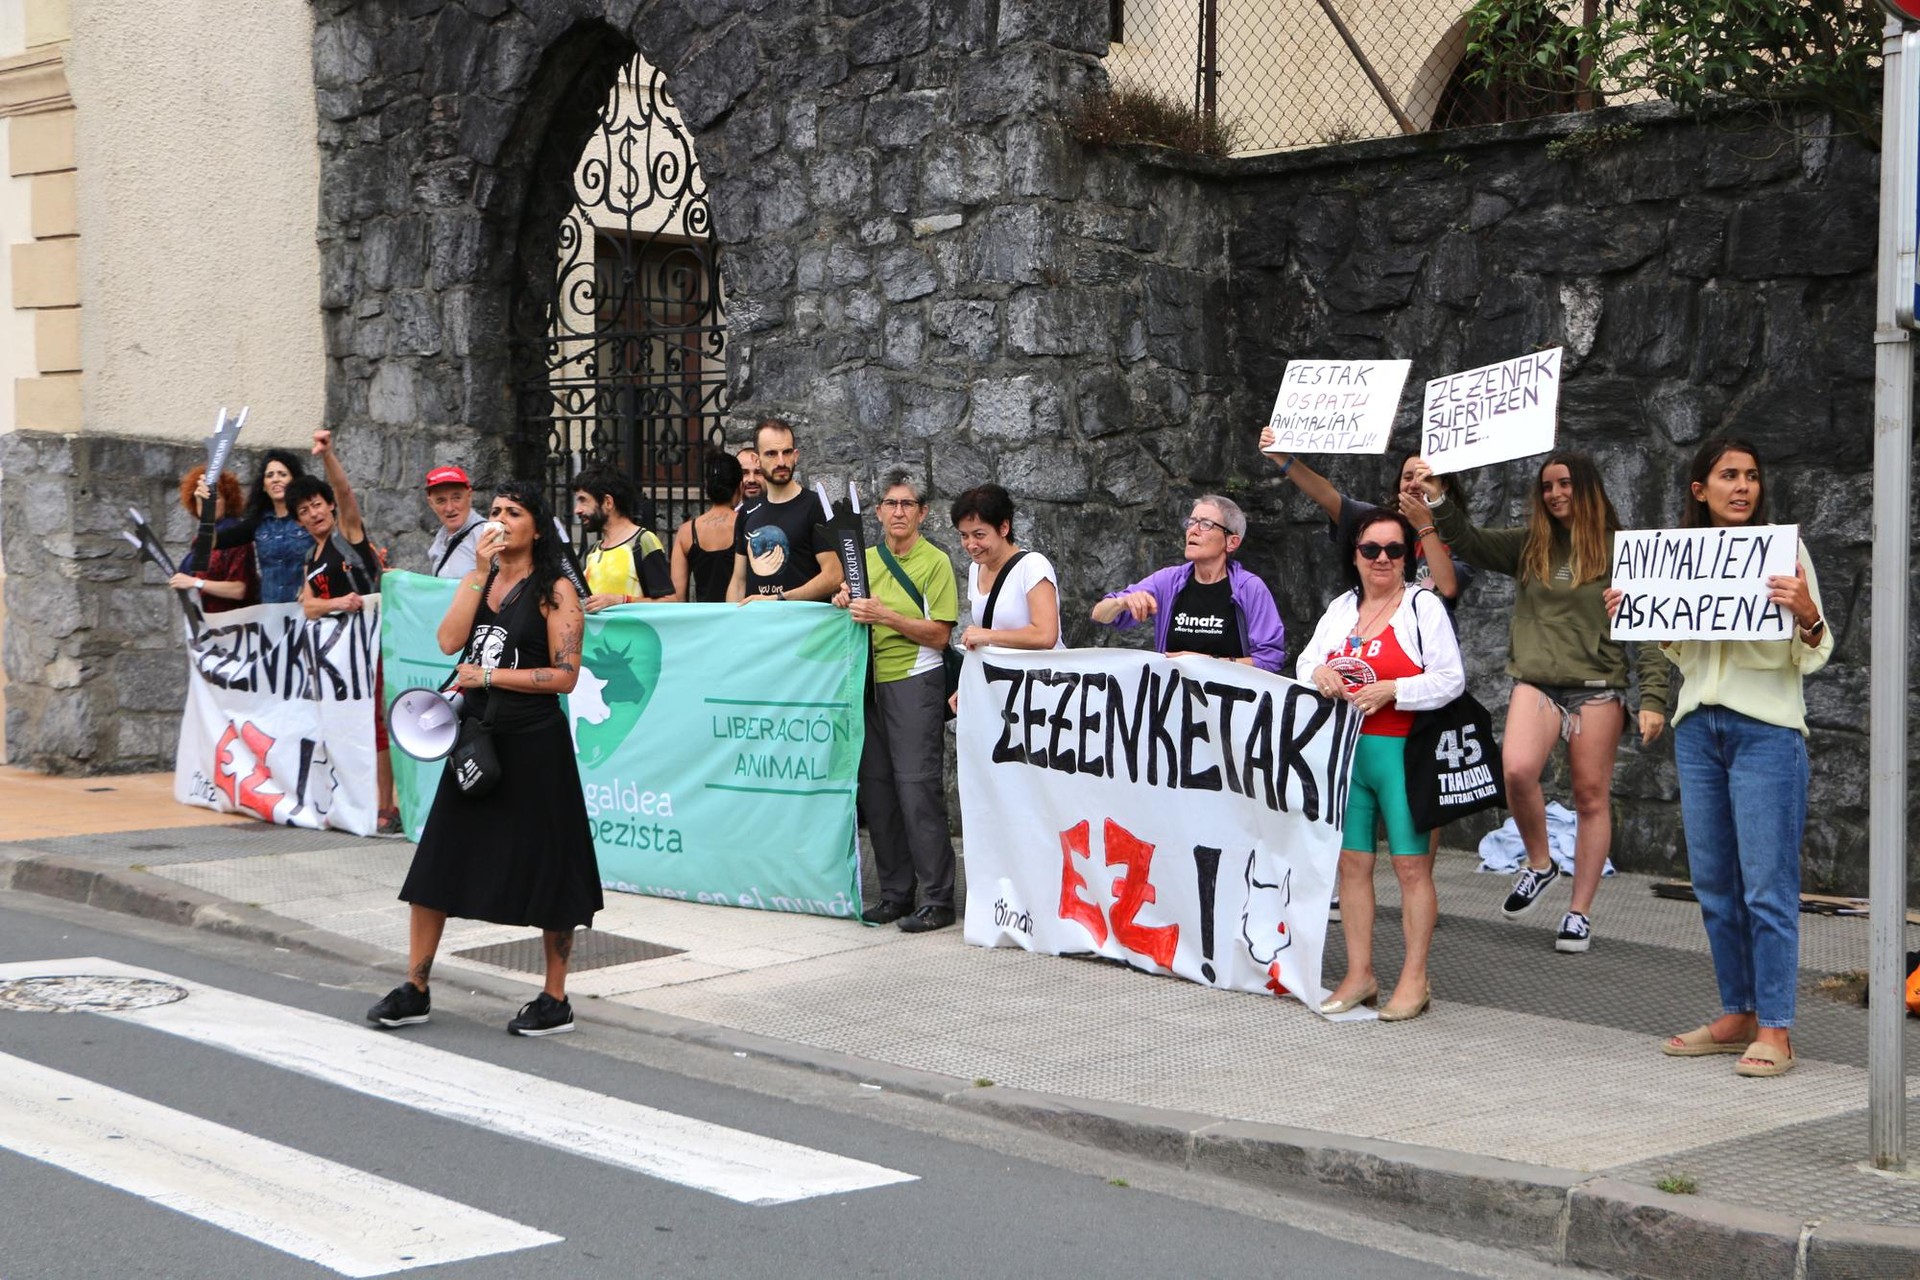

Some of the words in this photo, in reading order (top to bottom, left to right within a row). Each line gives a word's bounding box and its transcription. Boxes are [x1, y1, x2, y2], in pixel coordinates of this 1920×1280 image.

[1286, 365, 1375, 386] FESTAK
[1428, 353, 1555, 410] ZEZENAK
[1286, 393, 1371, 409] OSPATU
[843, 538, 861, 582] ESKUETAN
[1614, 593, 1785, 633] ASKAPENA
[713, 713, 850, 743] LIBERACIÓN
[1435, 723, 1483, 769] 45
[734, 753, 828, 781] ANIMAL
